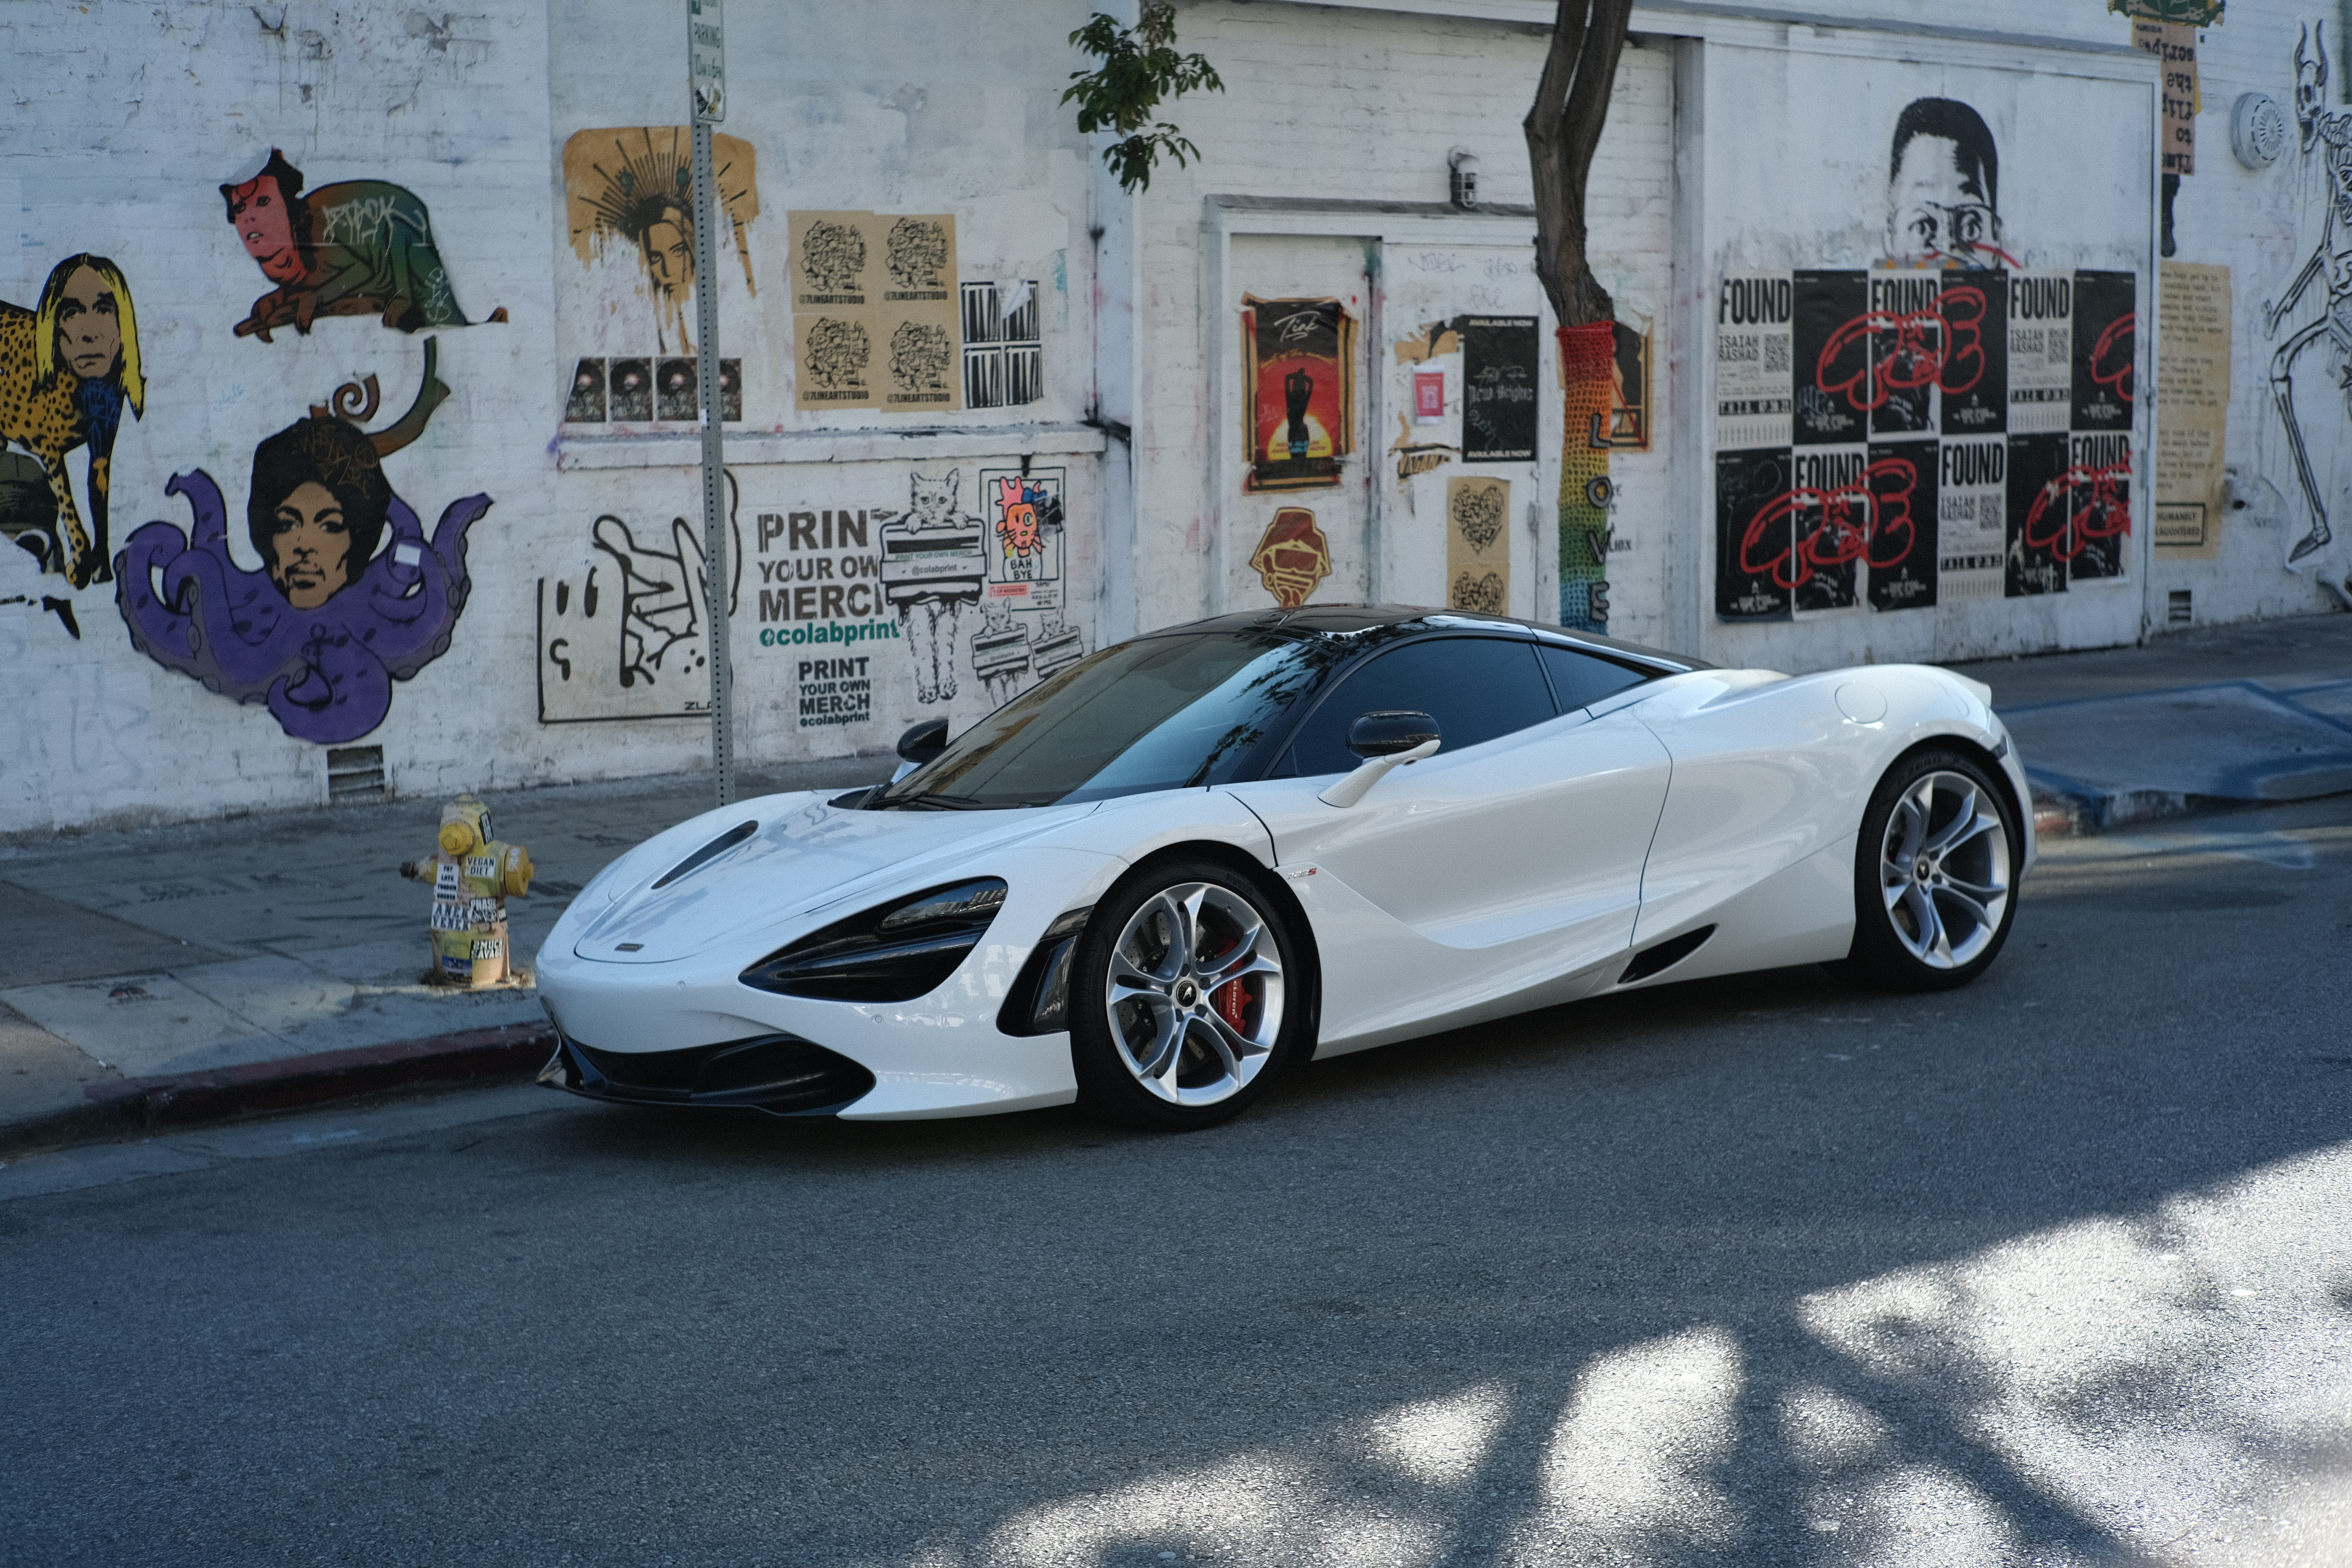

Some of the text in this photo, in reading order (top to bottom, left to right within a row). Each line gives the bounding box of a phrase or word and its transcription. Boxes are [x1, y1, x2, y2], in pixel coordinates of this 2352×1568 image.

[2167, 72, 2193, 94] the
[2176, 127, 2192, 147] to
[1720, 278, 1791, 324] FOUND
[1872, 278, 1938, 321] FOUND
[2010, 277, 2070, 319] FOUND
[1469, 319, 1534, 327] AVAILABLE NOW
[1467, 450, 1531, 459] AVAILABLE NOW
[2073, 435, 2130, 472] FOUND
[1796, 452, 1864, 493] FOUND
[1942, 443, 2004, 487] FOUND
[1586, 412, 1614, 623] LOVE
[2155, 525, 2200, 537] LAUGHTERED
[895, 553, 914, 561] PRINT
[950, 549, 972, 557] MERCH
[1010, 558, 1032, 570] BAH
[757, 555, 879, 584] YOUR OW
[911, 564, 958, 576] @colabprint
[1014, 569, 1033, 580] BYE
[759, 618, 900, 647] @colabprint
[798, 657, 870, 681] PRINT
[798, 678, 871, 696] YOUR OWN
[799, 693, 870, 716] MERCH
[799, 710, 870, 727] @colabprint
[467, 856, 495, 867] VEGAN
[470, 866, 488, 876] DIET
